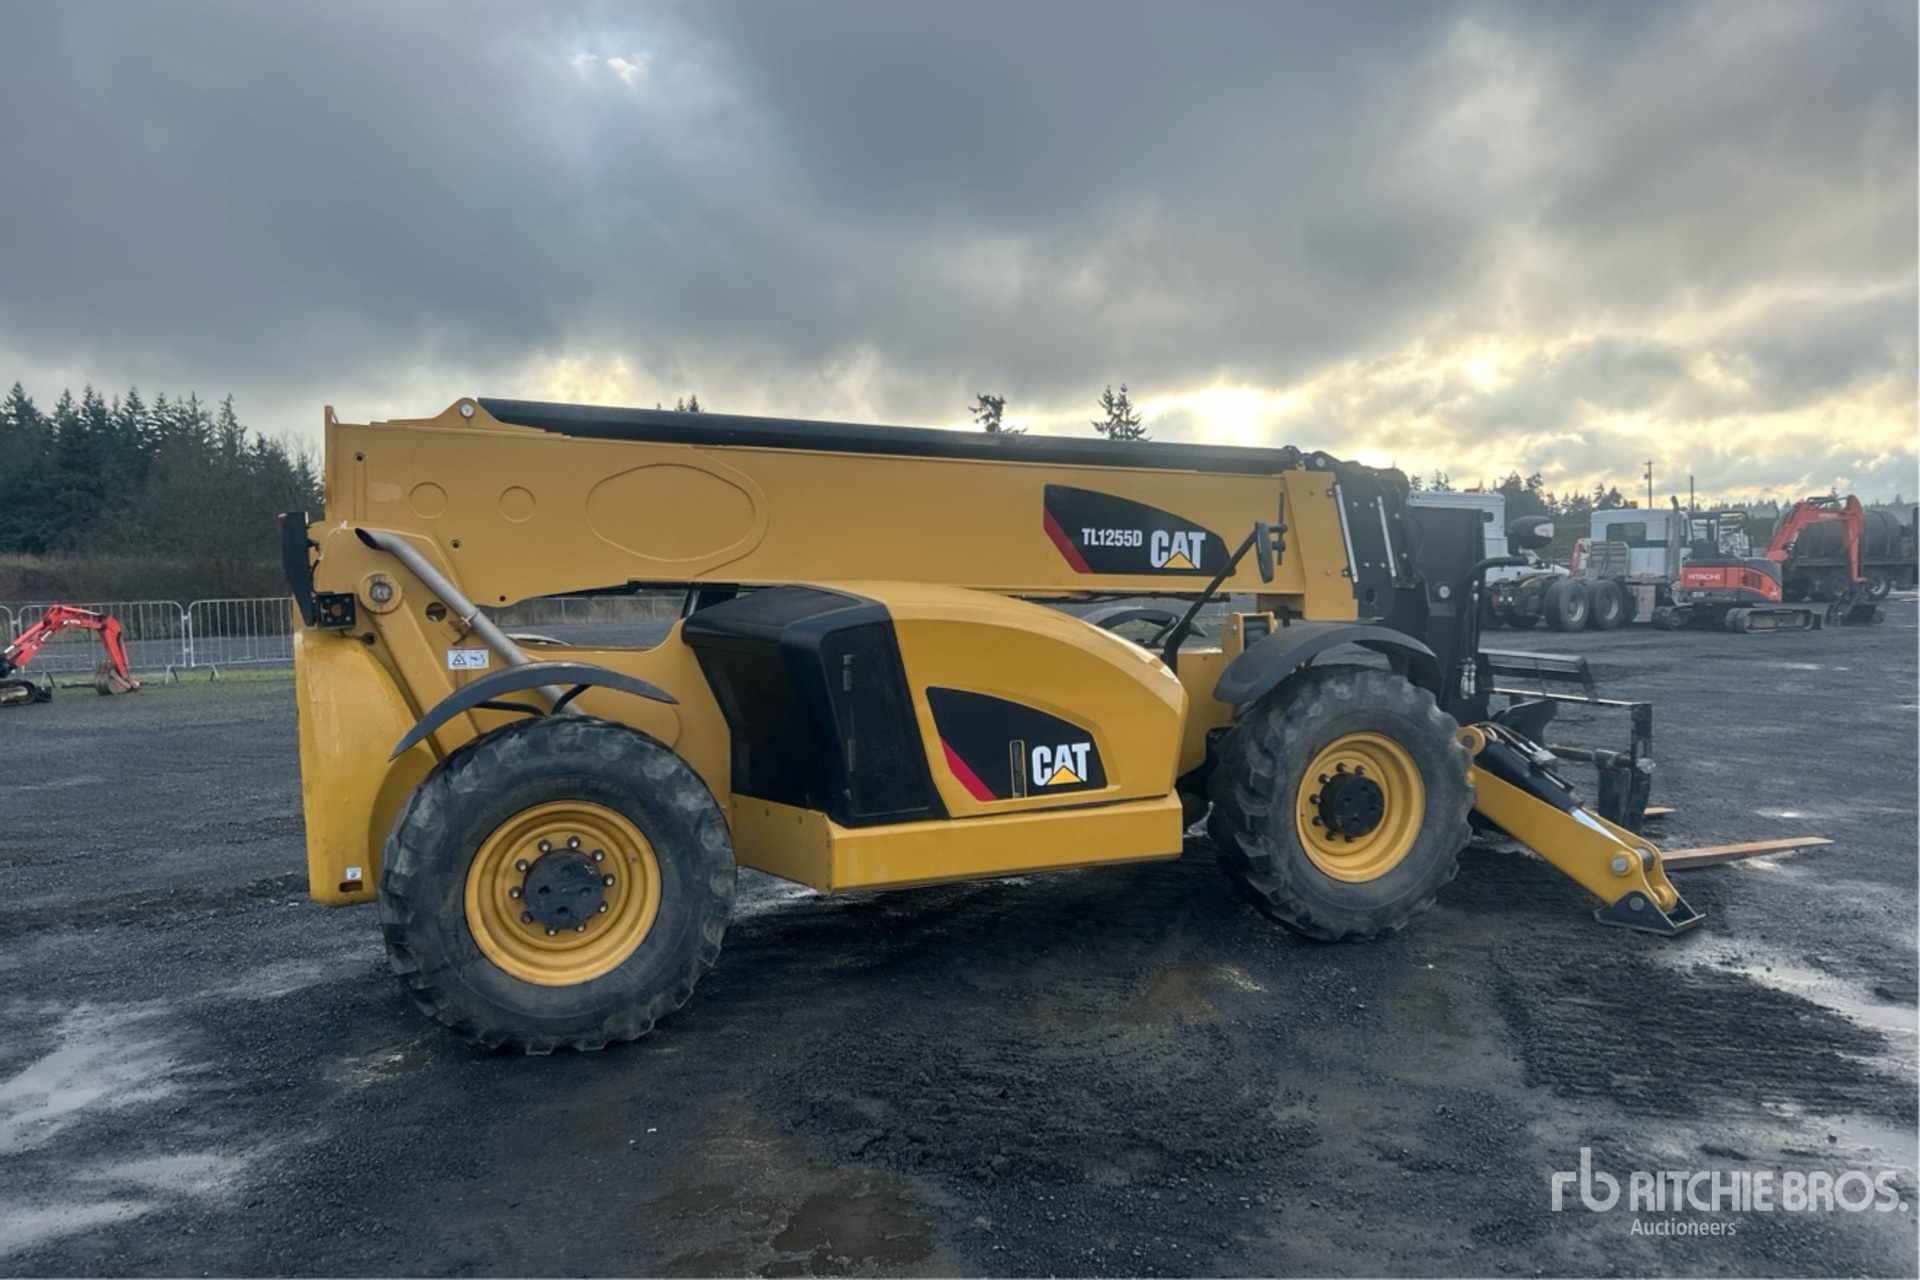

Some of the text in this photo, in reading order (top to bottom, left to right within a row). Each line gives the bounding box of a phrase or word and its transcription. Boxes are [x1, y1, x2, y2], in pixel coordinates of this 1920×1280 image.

[1081, 528, 1206, 570] TL1255D CAT
[1031, 742, 1091, 787] CAT
